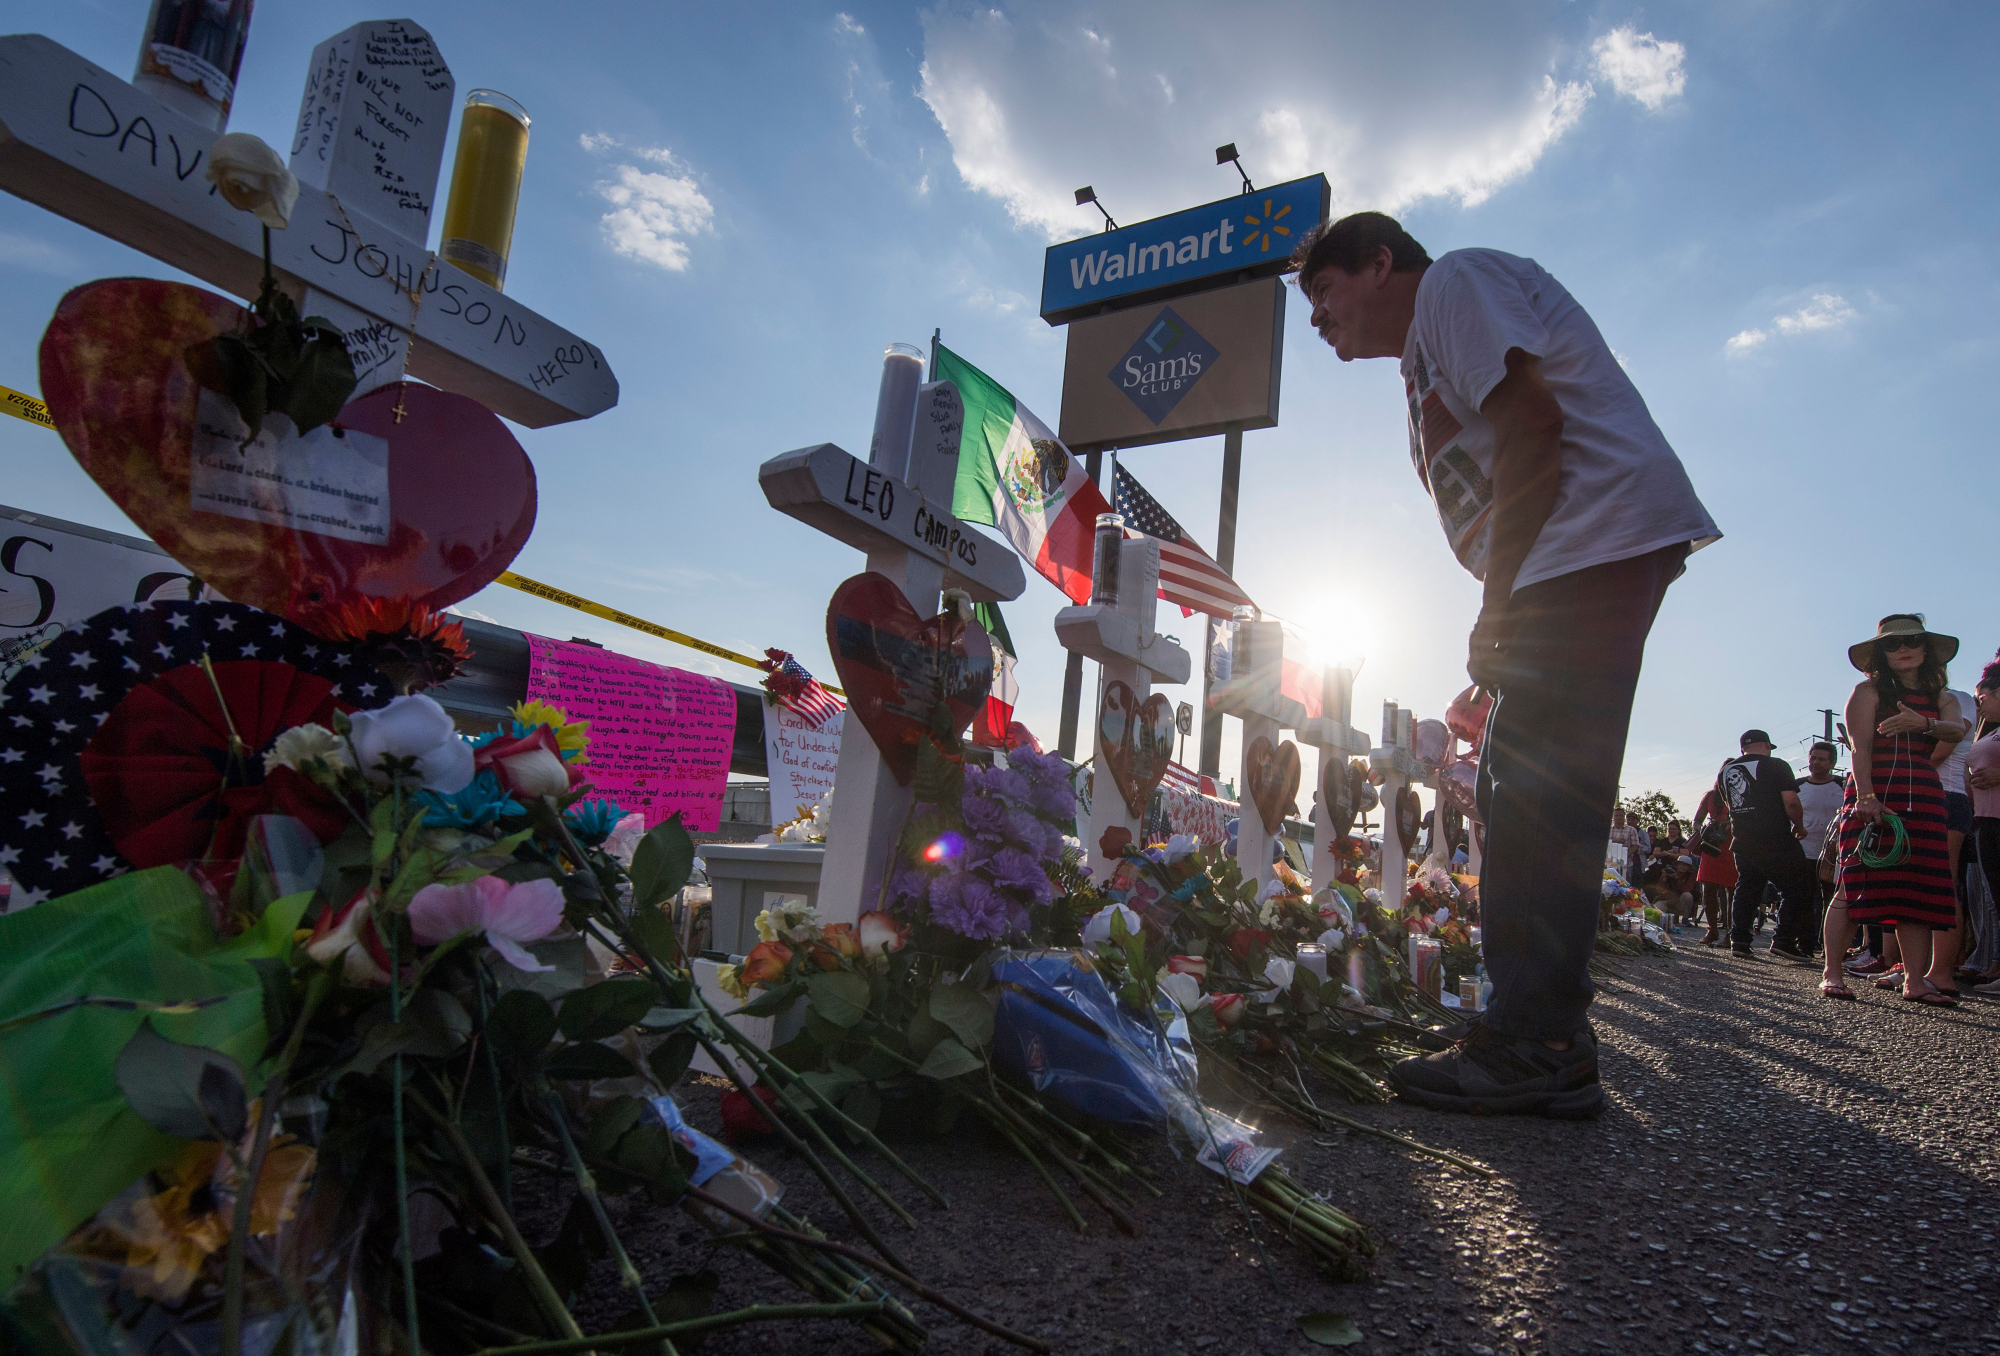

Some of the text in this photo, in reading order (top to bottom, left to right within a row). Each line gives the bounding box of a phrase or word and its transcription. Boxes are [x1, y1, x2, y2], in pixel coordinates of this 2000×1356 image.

[372, 31, 401, 46] Loving
[382, 76, 402, 94] WE
[363, 101, 410, 143] FORGET
[395, 103, 423, 127] NOT
[1070, 218, 1234, 290] Walmart
[310, 219, 526, 346] JOHNSON
[529, 340, 598, 391] HERO!
[1124, 352, 1202, 388] Sam's
[1140, 379, 1182, 396] CLUB
[7, 393, 45, 412] CRUZA
[219, 460, 243, 474] Lord
[255, 468, 282, 482] close
[310, 480, 342, 496] broken
[344, 488, 379, 506] hearted
[310, 512, 347, 528] crushed
[844, 456, 977, 566] LEO CAMPOS
[520, 582, 536, 593] CROSS
[536, 588, 546, 597] NOT
[554, 594, 566, 603] LINE
[565, 598, 582, 608] POLICE
[532, 651, 546, 662] For
[589, 663, 611, 674] there
[611, 666, 618, 674] is
[628, 670, 652, 680] season
[654, 673, 668, 682] and
[530, 677, 550, 690] Die,
[560, 681, 579, 690] time
[594, 686, 616, 695] plant
[644, 690, 661, 700] time
[675, 695, 694, 703] pluck
[726, 700, 734, 708] is
[569, 674, 595, 684] under
[599, 676, 626, 687] heaven
[672, 686, 687, 694] born
[574, 694, 594, 704] time
[598, 698, 606, 706] to
[610, 699, 624, 708] kill
[630, 702, 643, 710] and
[654, 704, 672, 714] time
[677, 706, 684, 714] to
[718, 709, 732, 718] time
[575, 712, 595, 720] down
[623, 714, 640, 724] time
[656, 718, 676, 726] build
[697, 720, 714, 728] time
[778, 707, 804, 730] Lord
[592, 724, 615, 736] laugh
[643, 728, 660, 737] time
[668, 730, 675, 738] to
[678, 732, 702, 742] mourn
[778, 729, 796, 748] for
[588, 750, 614, 759] stones
[619, 752, 650, 763] together
[661, 756, 678, 764] time
[692, 757, 722, 766] embrace
[603, 741, 620, 750] time
[625, 742, 632, 750] to
[654, 748, 674, 757] away
[783, 750, 798, 766] God
[801, 756, 810, 768] of
[614, 761, 631, 770] from
[676, 764, 694, 773] But
[697, 768, 726, 776] precious
[637, 771, 658, 779] death
[790, 772, 832, 788] Stay close to
[662, 790, 678, 798] and
[682, 790, 704, 798] blinds
[792, 784, 816, 800] Jesus
[643, 805, 714, 822] El Pao Tx
